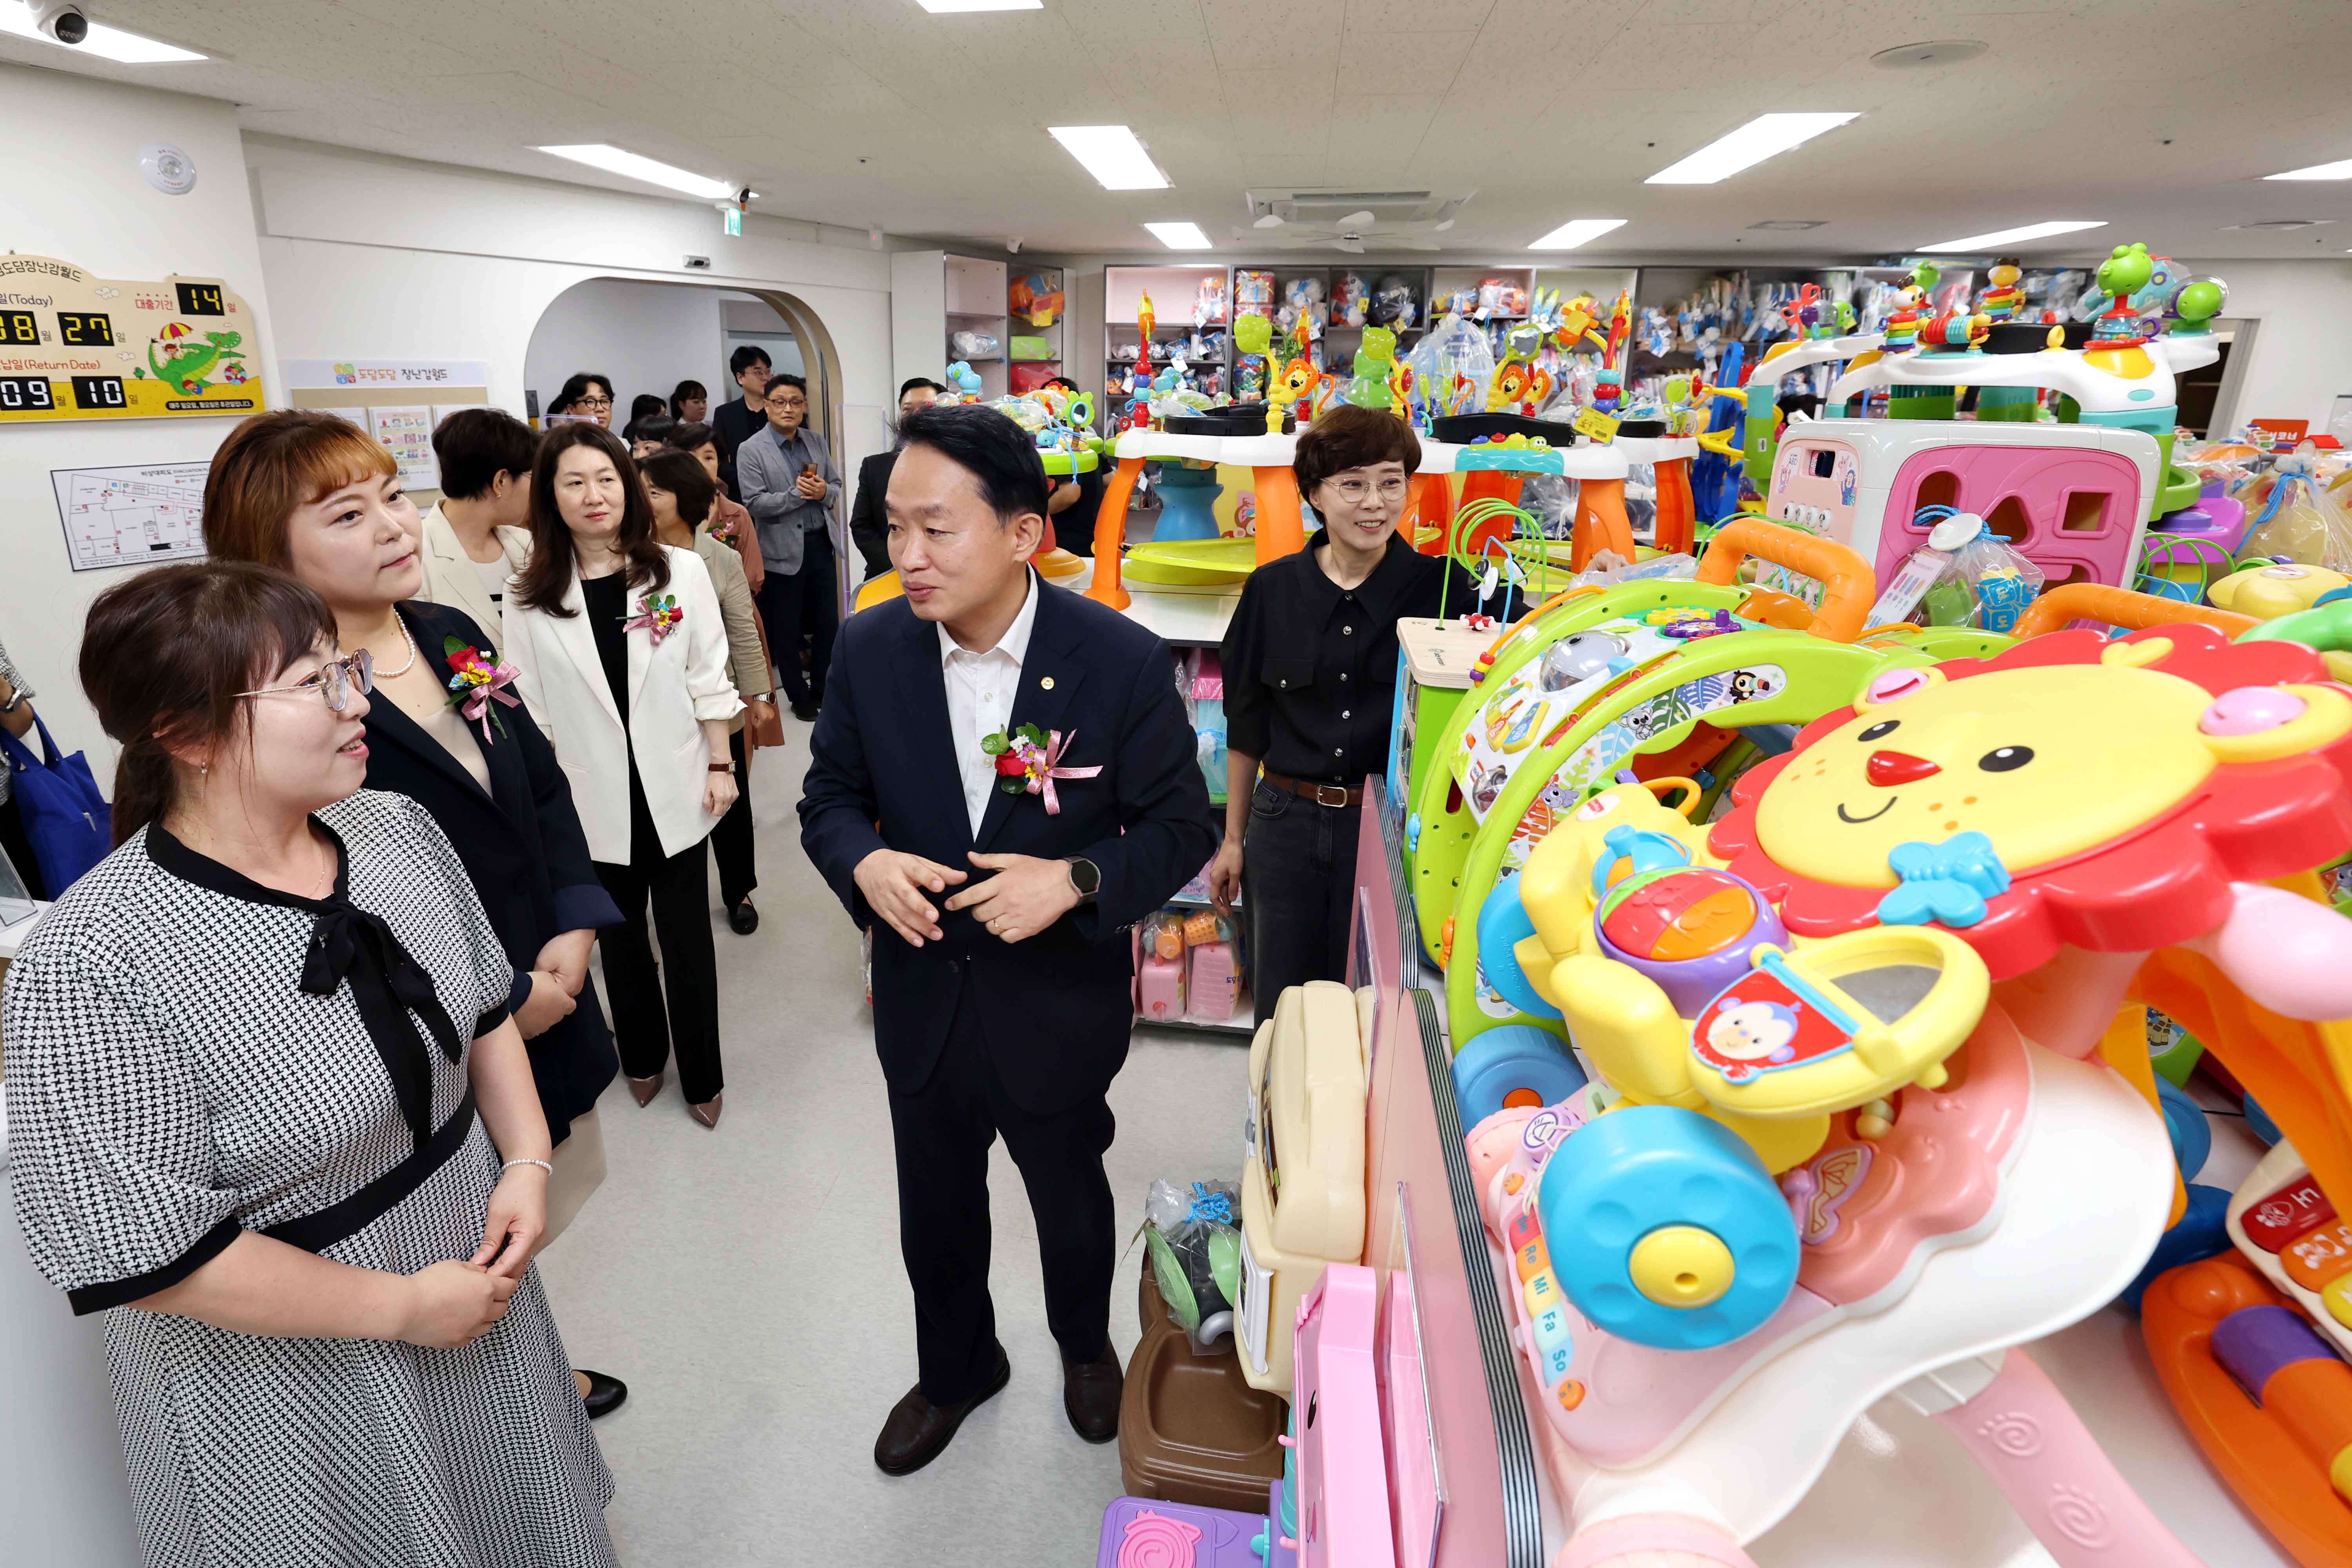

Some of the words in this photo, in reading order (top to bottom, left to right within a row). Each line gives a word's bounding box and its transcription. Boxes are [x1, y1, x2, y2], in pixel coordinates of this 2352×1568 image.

[135, 299, 174, 310] 대출기간
[191, 289, 220, 311] 14
[227, 303, 236, 312] 일
[64, 317, 110, 341] 27
[0, 359, 68, 370] 납일(Return
[70, 360, 100, 370] Date)
[358, 369, 396, 380] 도담도담
[401, 369, 448, 381] 장난감월드
[0, 381, 50, 406] 09
[89, 380, 122, 403] 10
[1517, 1215, 1528, 1232] Do
[1525, 1244, 1537, 1264] Re
[1534, 1276, 1549, 1295] Mi
[1543, 1311, 1555, 1332] Fa
[1553, 1349, 1566, 1372] So
